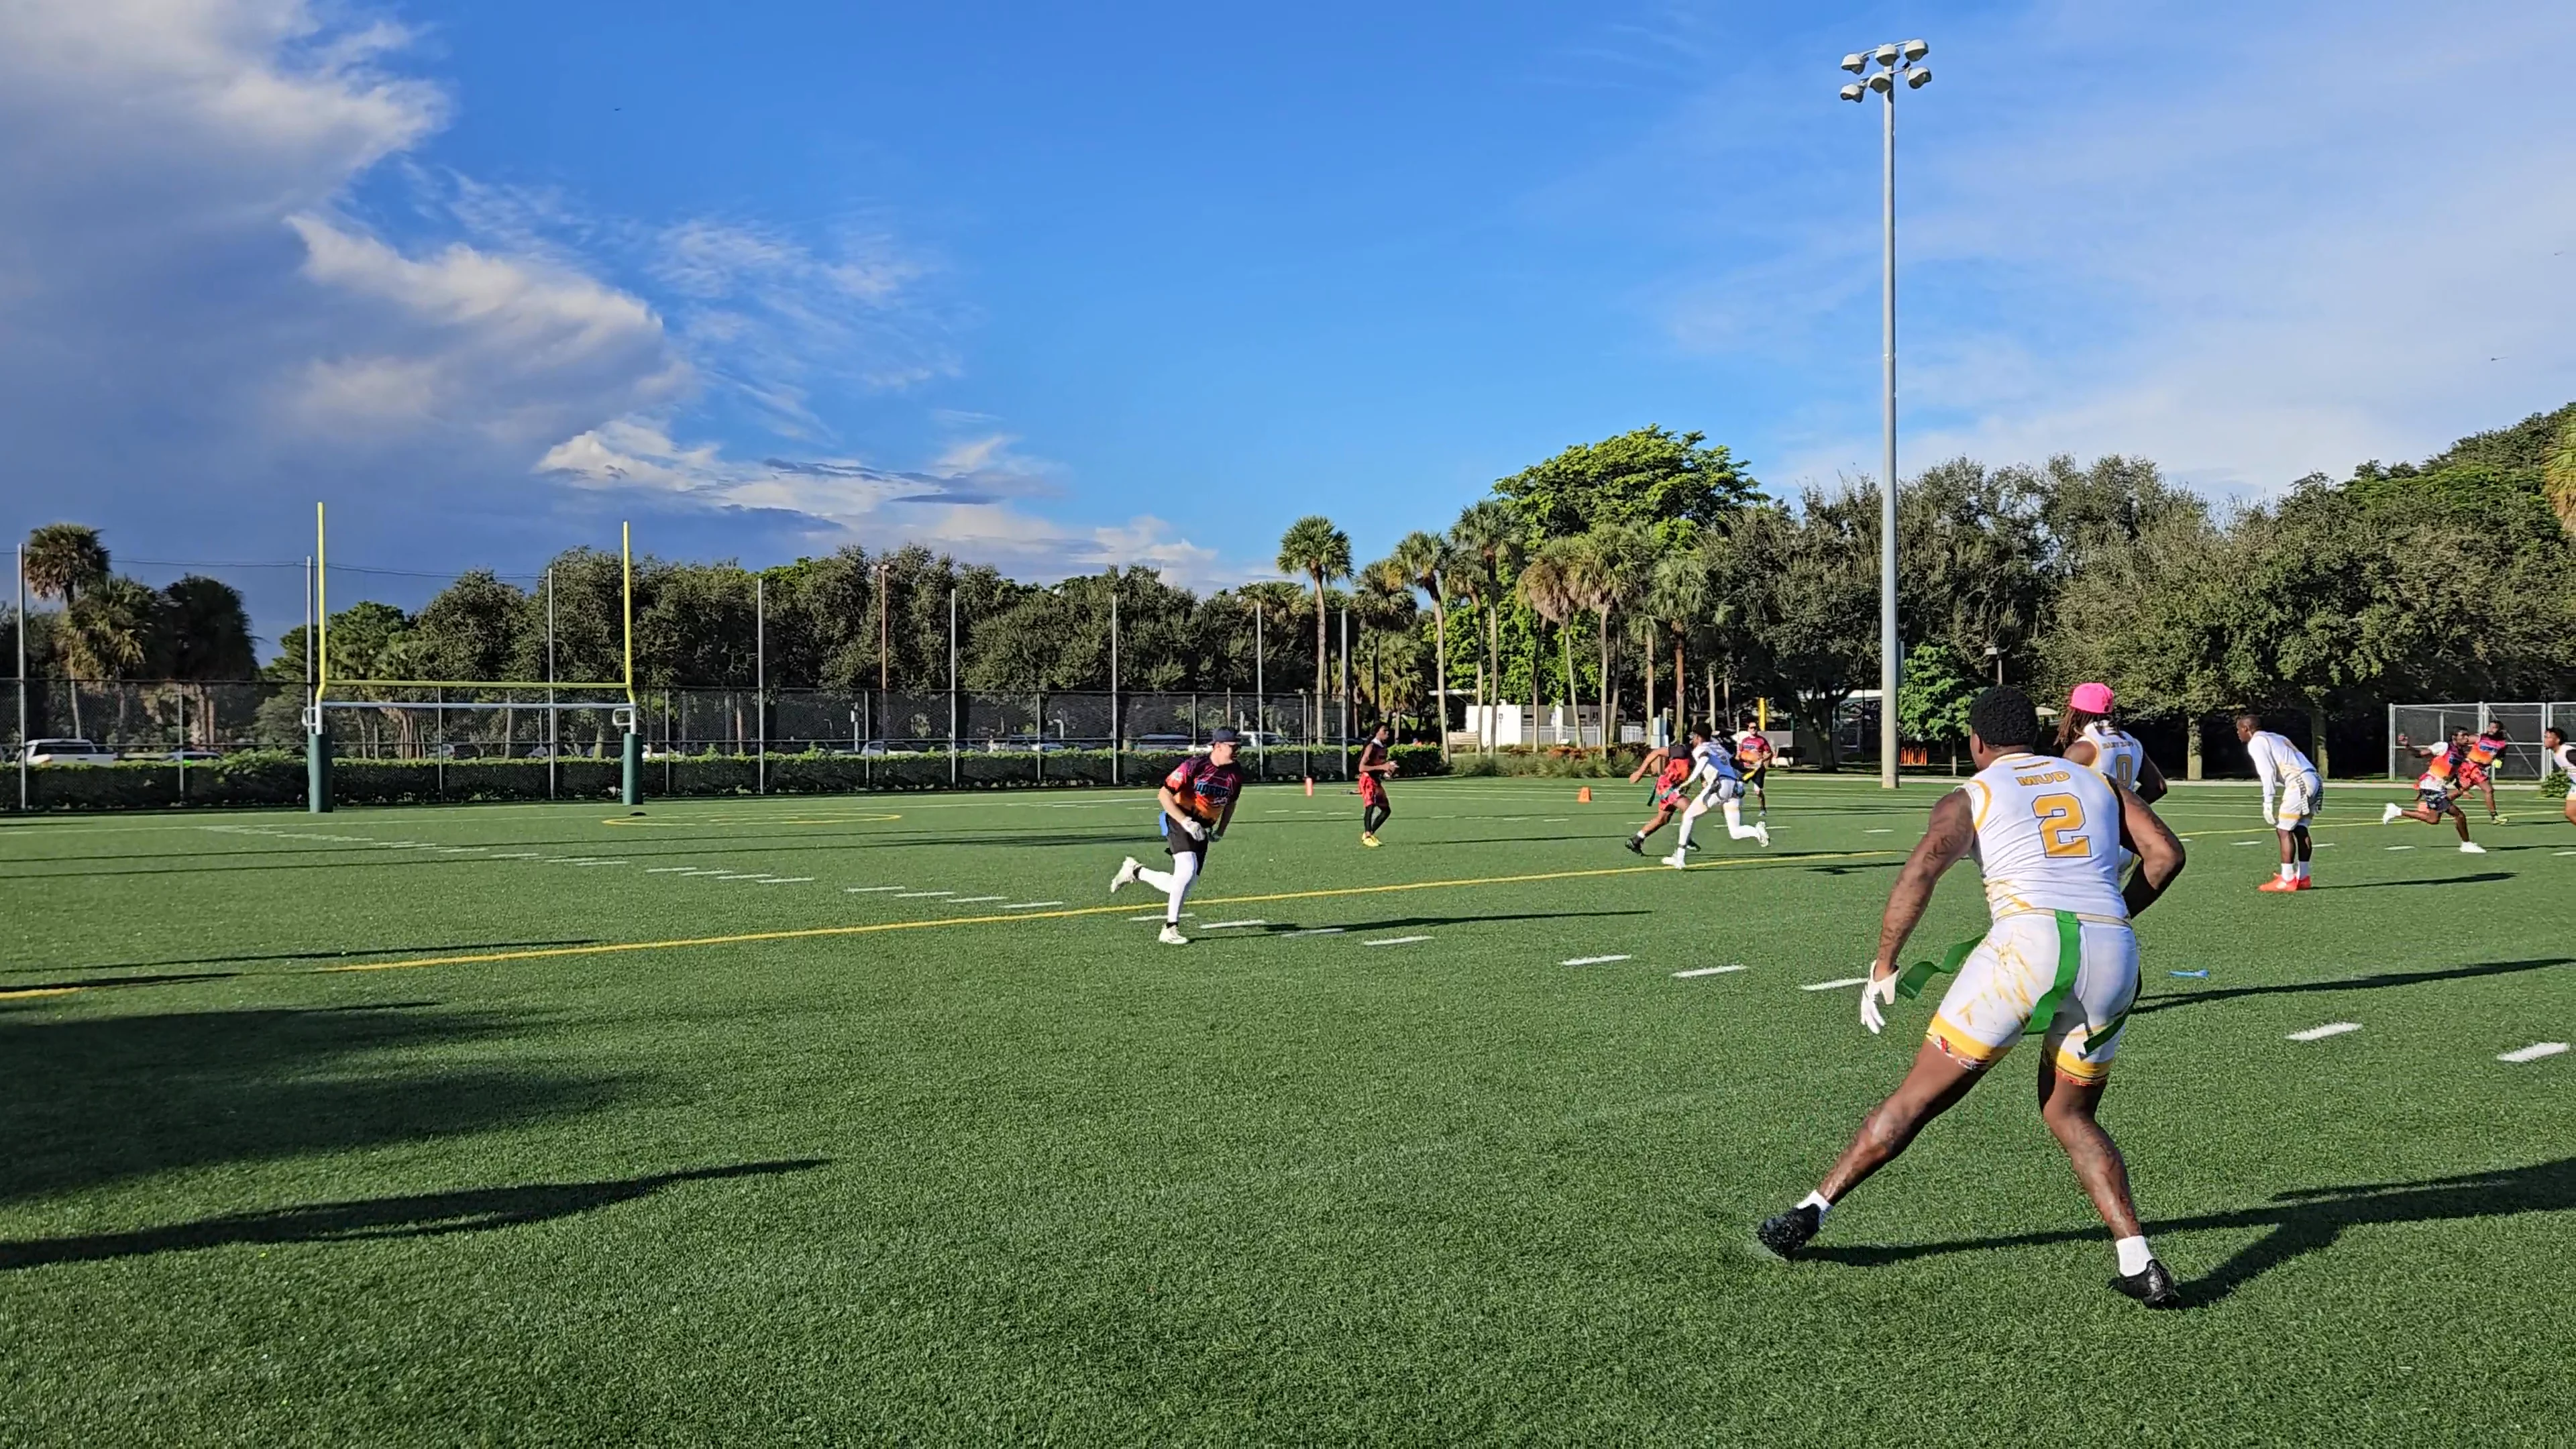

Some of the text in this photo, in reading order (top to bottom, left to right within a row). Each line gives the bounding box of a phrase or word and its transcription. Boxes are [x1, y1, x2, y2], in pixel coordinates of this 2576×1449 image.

[2015, 771, 2070, 786] MUD
[2115, 753, 2133, 788] 0
[2031, 792, 2092, 858] 2
